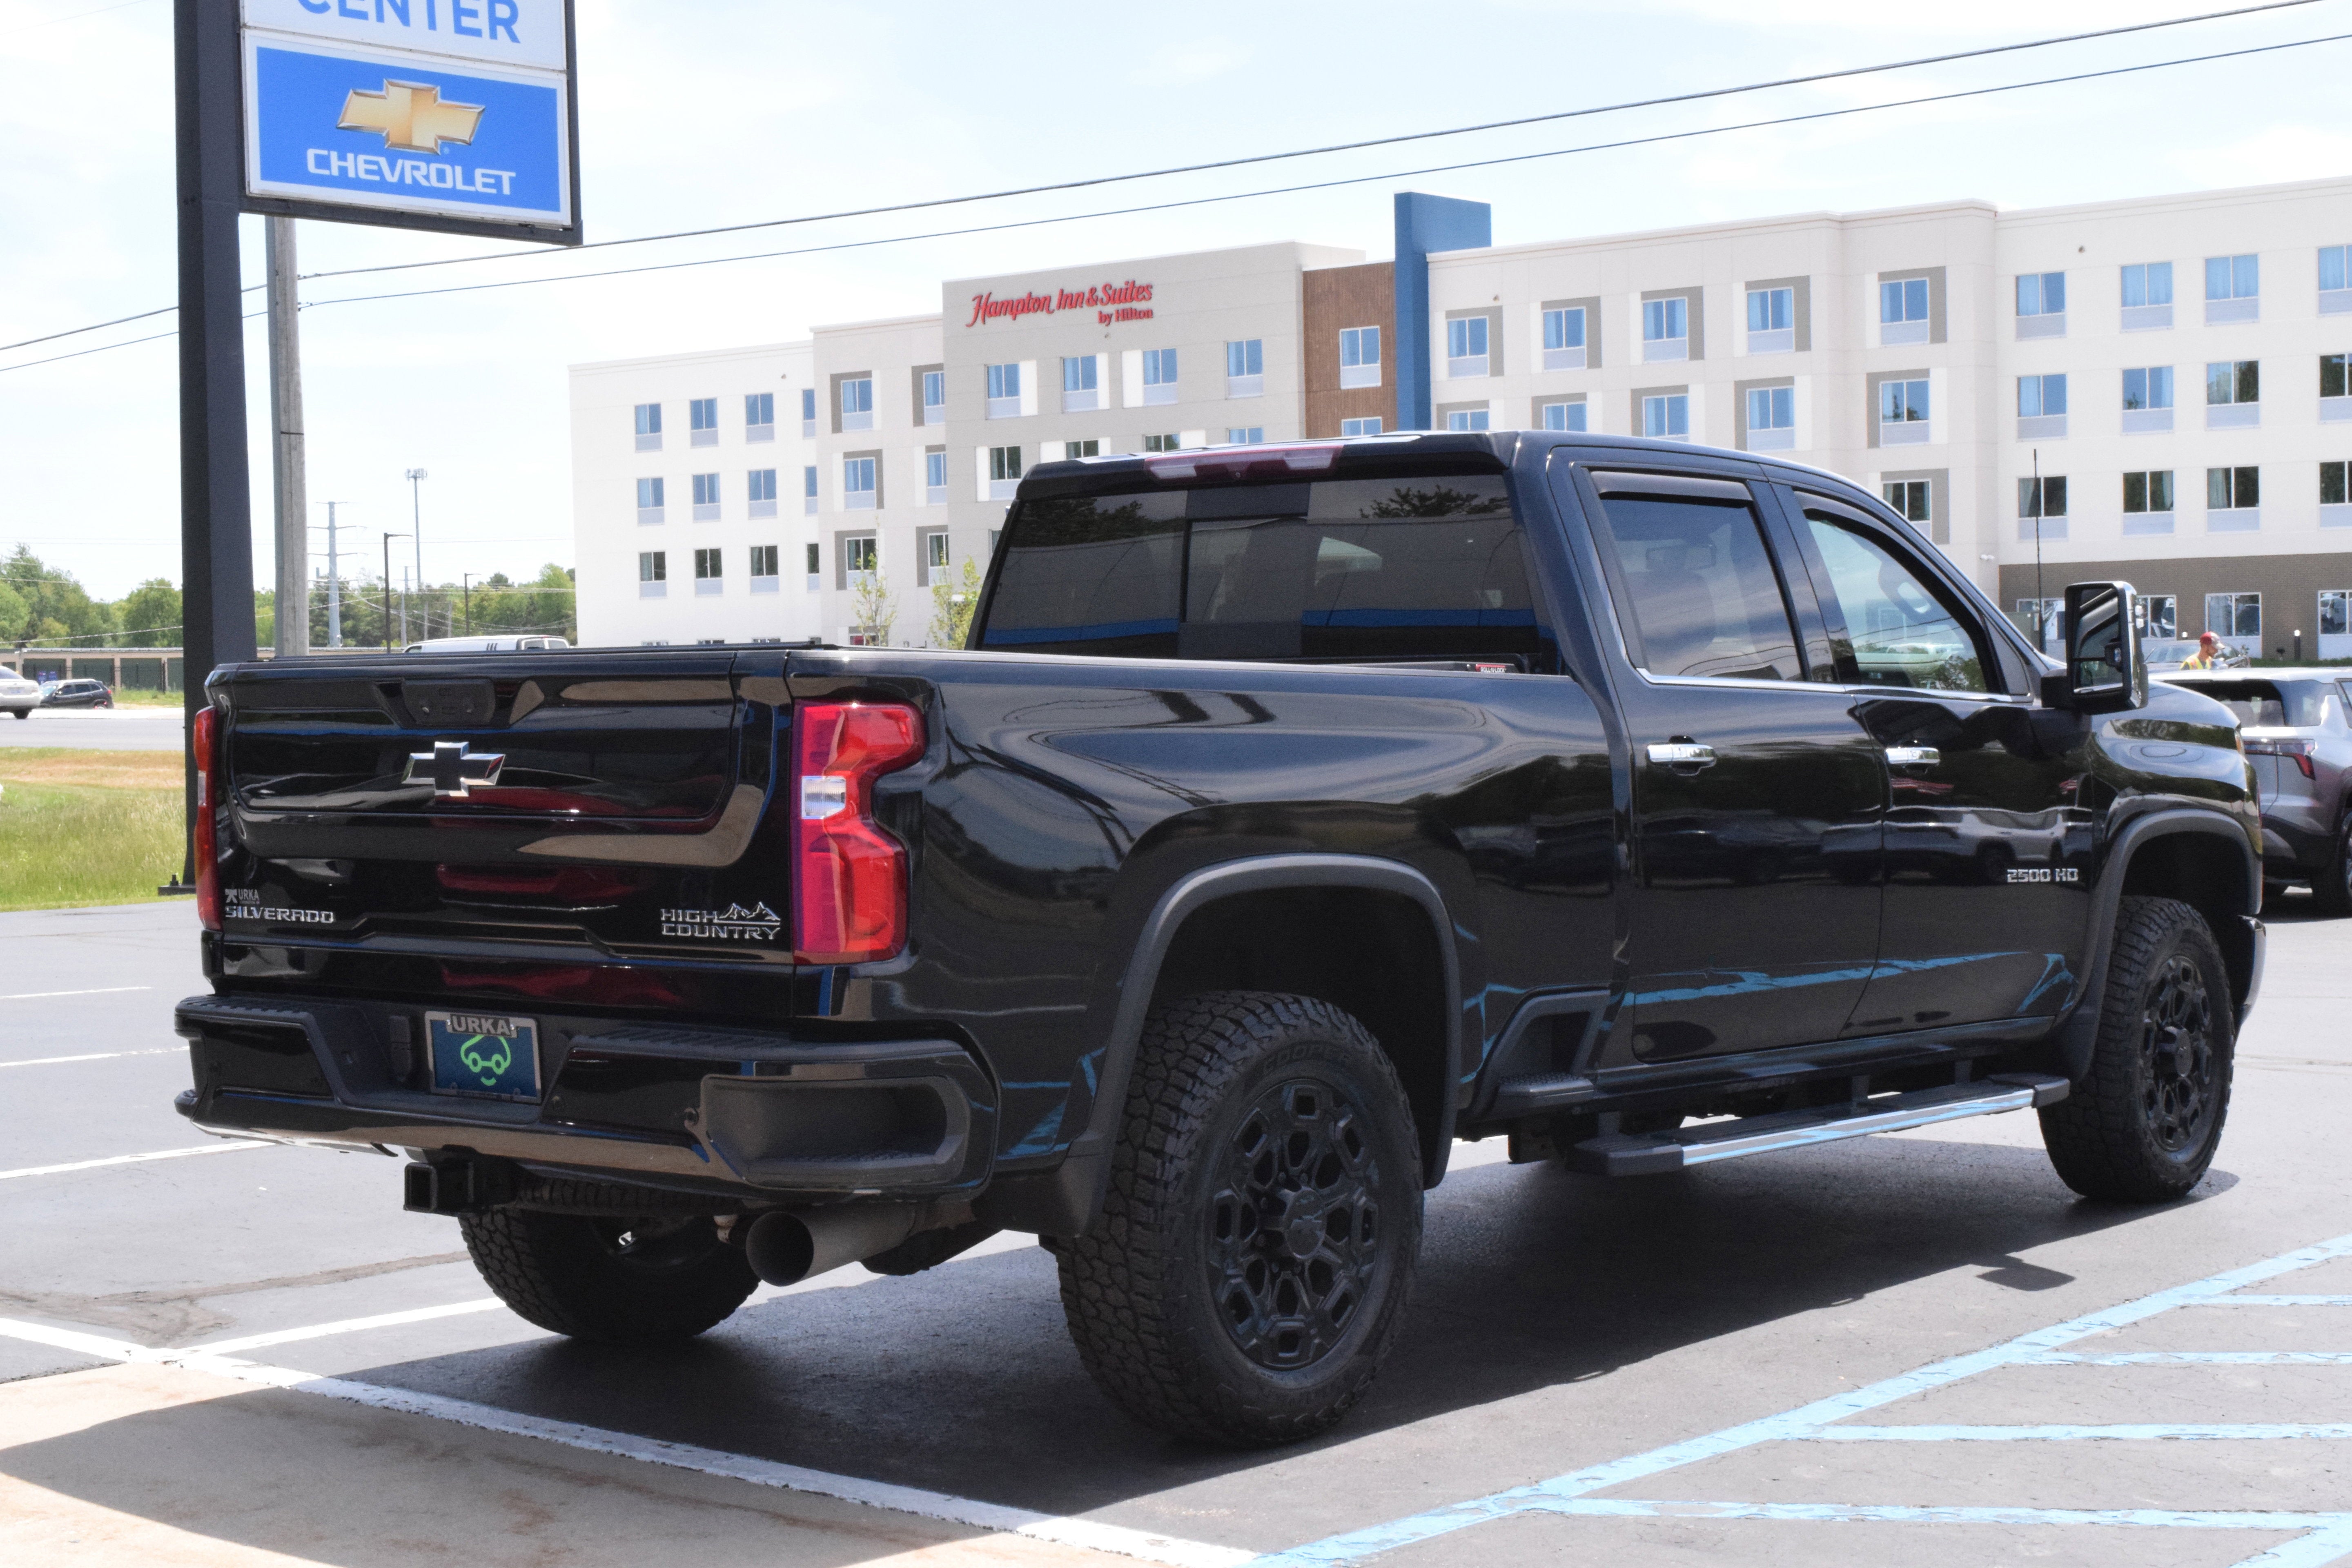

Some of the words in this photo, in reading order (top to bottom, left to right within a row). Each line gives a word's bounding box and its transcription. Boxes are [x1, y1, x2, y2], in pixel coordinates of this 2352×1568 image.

[307, 147, 516, 195] CHEVROLET
[966, 291, 1054, 327] Hampton
[1056, 288, 1084, 311] Inn
[1085, 287, 1098, 307] &
[1099, 280, 1153, 306] Suites
[1098, 310, 1112, 326] by
[1115, 307, 1153, 322] Hilton
[2007, 869, 2051, 883] 2500
[2055, 868, 2078, 882] HD
[238, 889, 259, 901] URKA
[225, 905, 334, 924] SILVERADO
[661, 909, 717, 923] HIGH
[662, 923, 780, 940] COUNTRY
[452, 1015, 510, 1036] URKA
